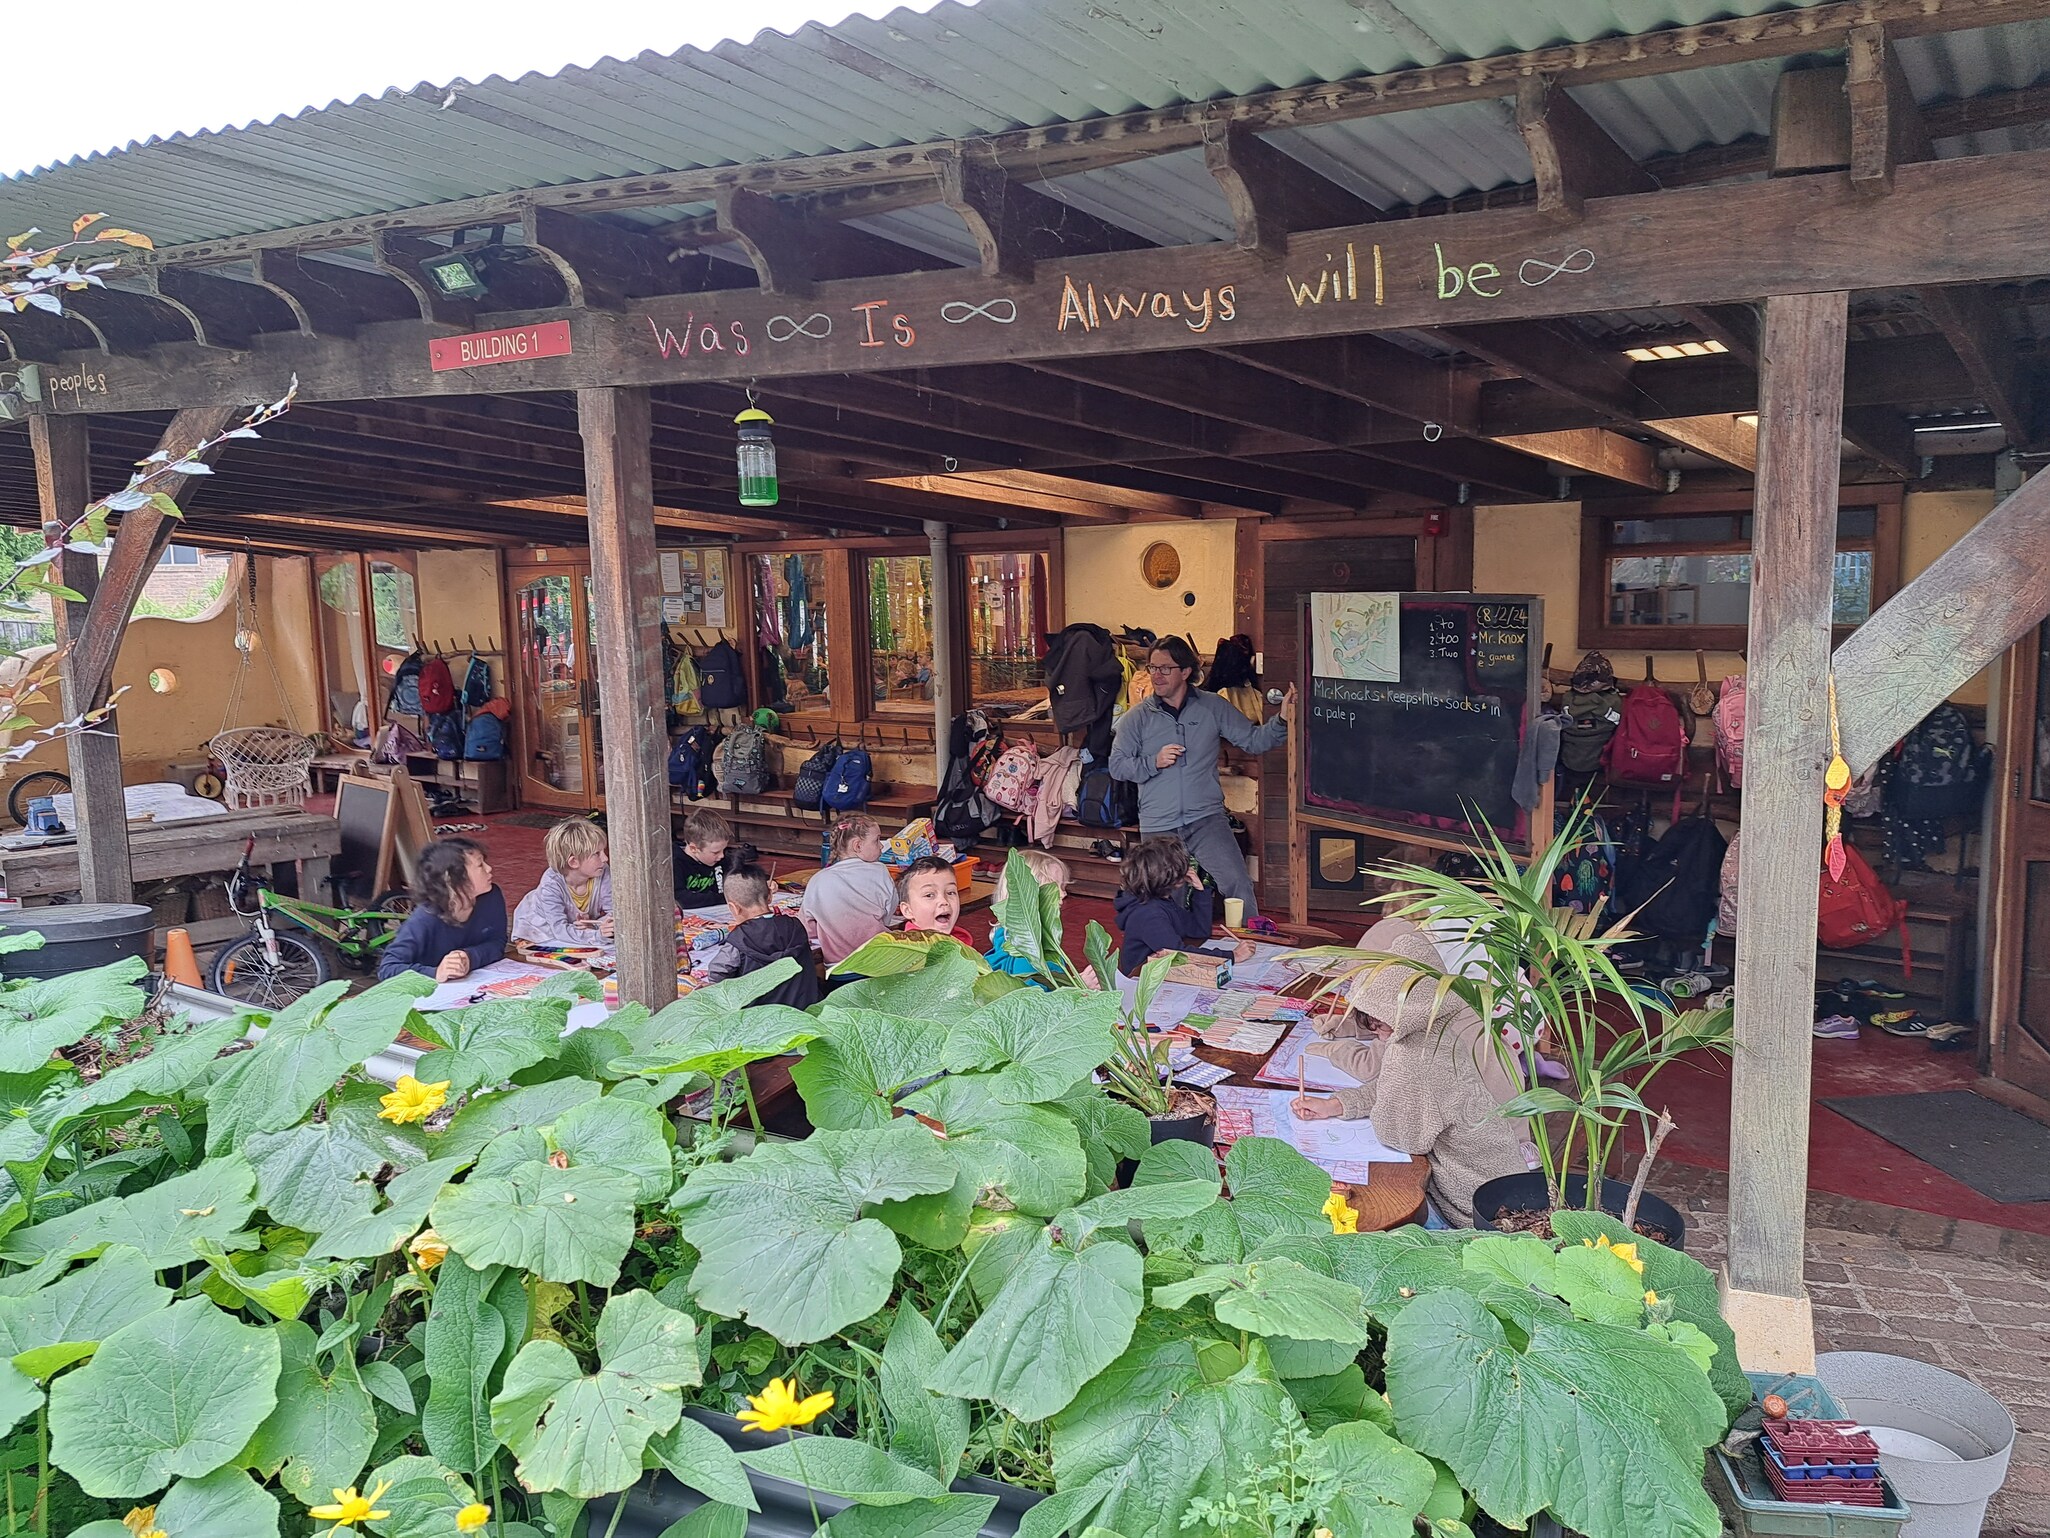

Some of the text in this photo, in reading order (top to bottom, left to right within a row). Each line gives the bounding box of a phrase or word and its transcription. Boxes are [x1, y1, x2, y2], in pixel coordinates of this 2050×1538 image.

[646, 242, 1502, 359] Was Is Always will be
[460, 331, 538, 362] BUILDING 1
[49, 362, 107, 410] peoples
[1440, 633, 1460, 645] too
[1478, 630, 1496, 645] Mr.
[1488, 653, 1516, 667] games
[1314, 678, 1332, 699] Mr.
[1334, 680, 1380, 702] Knocks
[1387, 685, 1419, 711] keeps
[1421, 687, 1440, 707] his
[1490, 704, 1501, 717] in
[1313, 705, 1356, 729] a pale p
